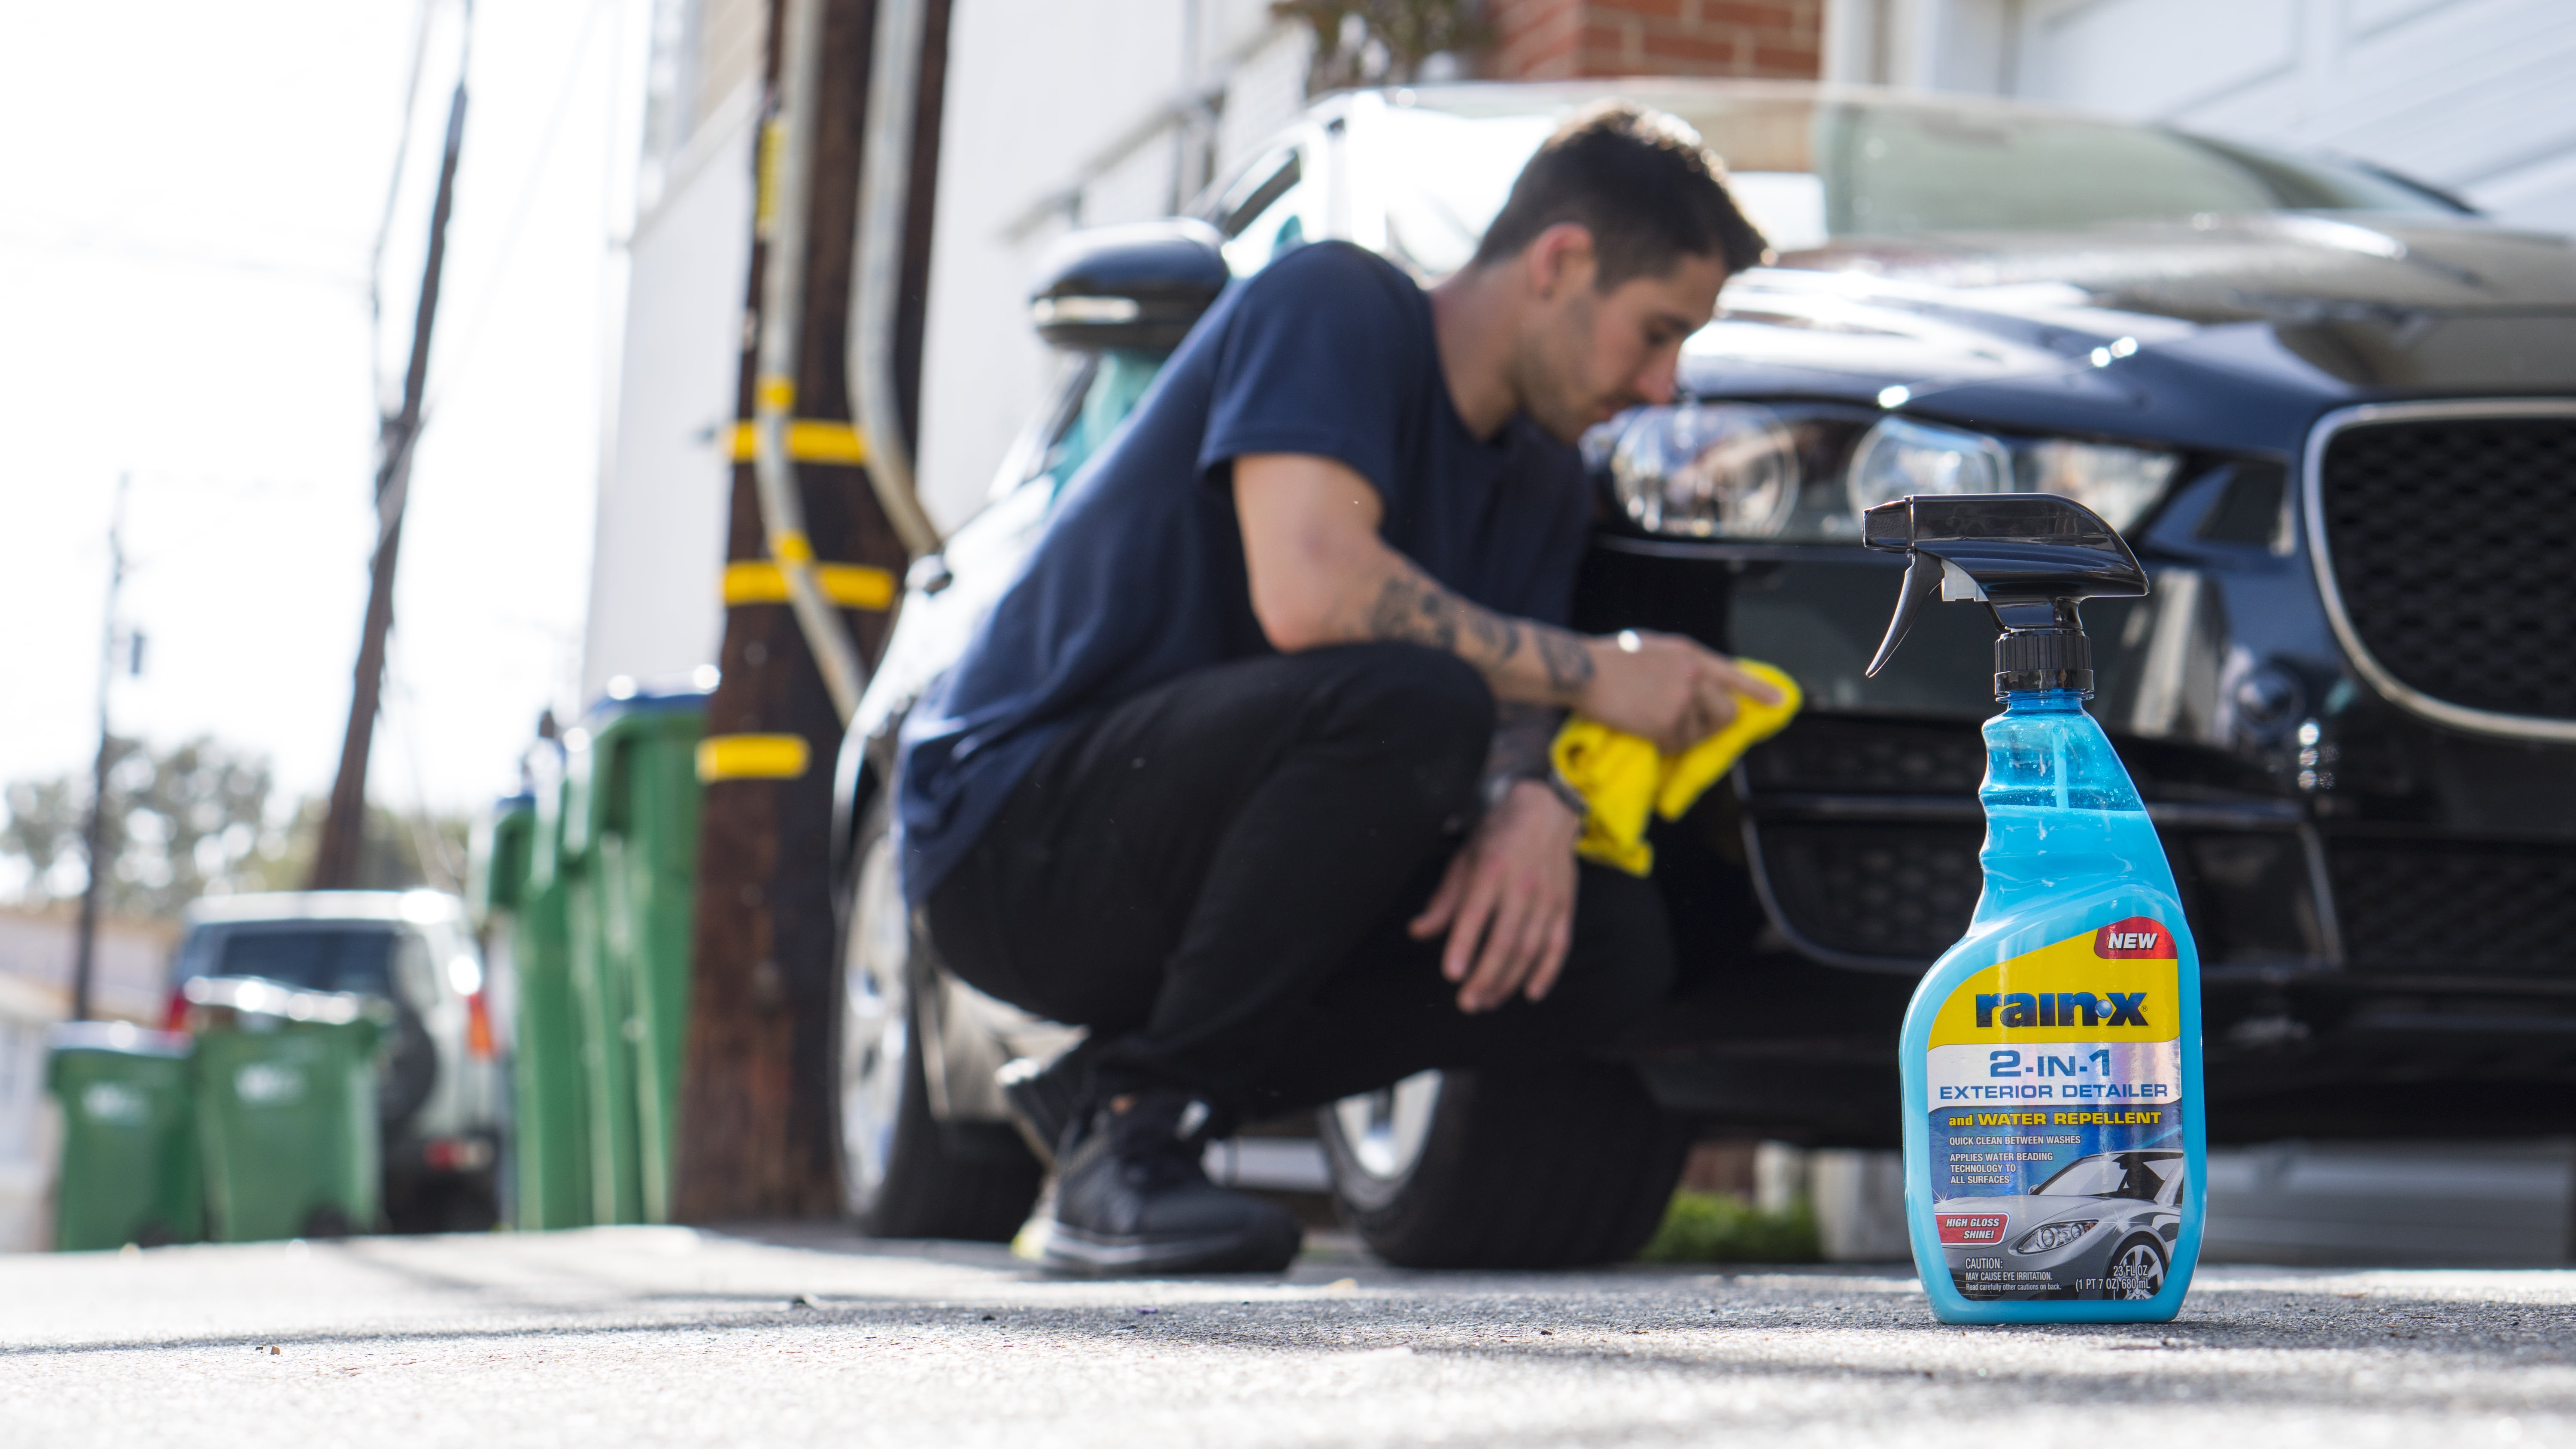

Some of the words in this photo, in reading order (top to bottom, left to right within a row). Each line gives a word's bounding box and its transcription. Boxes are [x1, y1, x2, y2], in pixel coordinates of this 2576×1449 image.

[2108, 933, 2157, 949] NEW
[1990, 1049, 2111, 1077] 2-IN-1
[1940, 1085, 2053, 1099] EXTERIOR
[2063, 1084, 2167, 1098] DETAILER
[1949, 1116, 1972, 1126] and
[1978, 1113, 2046, 1125] WATER
[2054, 1112, 2161, 1124] REPELLENT
[1950, 1137, 1974, 1145] QUICK
[1976, 1137, 2002, 1145] CLEAN
[2005, 1136, 2043, 1144] BETWEEN
[2046, 1136, 2081, 1144] WASHES
[1950, 1153, 1983, 1161] APPLIES
[1985, 1153, 2014, 1161] WATER
[2017, 1152, 2053, 1161] BEADING
[1950, 1164, 2003, 1173] TECHNOLOGY
[2005, 1164, 2016, 1172] TO
[1970, 1219, 1999, 1227] GLOSS
[1963, 1231, 1994, 1239] SHINE!
[1965, 1258, 2003, 1269] CAUTION:
[2113, 1266, 2123, 1276] 23
[2126, 1266, 2135, 1276] FL
[2137, 1265, 2148, 1276] OZ
[1981, 1272, 2001, 1280] CAUSE
[2003, 1272, 2015, 1280] EYE
[2017, 1272, 2053, 1280] IRRITATION.
[1980, 1283, 2001, 1292] carefully
[2076, 1279, 2082, 1291] (1
[2086, 1279, 2096, 1289] PT
[2099, 1279, 2103, 1289] 7
[2106, 1279, 2119, 1291] OZ)
[2121, 1278, 2136, 1289] 680
[2139, 1278, 2151, 1288] mL
